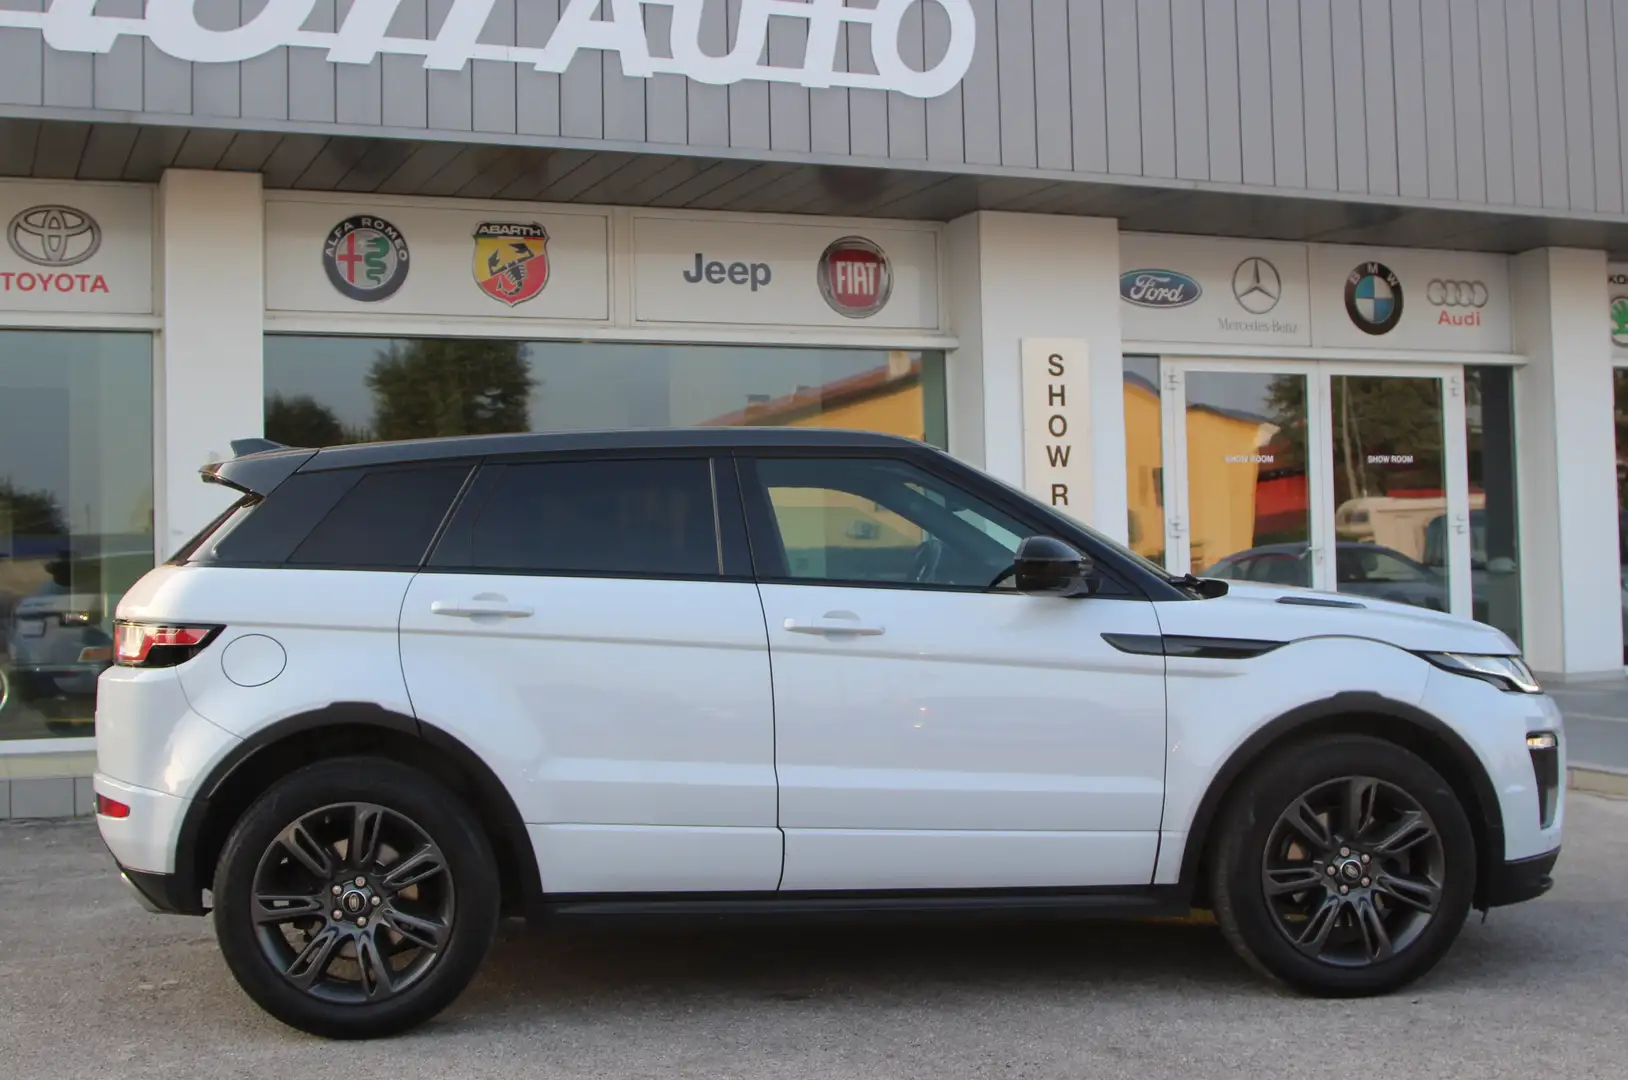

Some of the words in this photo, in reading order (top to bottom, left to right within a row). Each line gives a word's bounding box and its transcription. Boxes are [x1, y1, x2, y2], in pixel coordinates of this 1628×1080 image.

[325, 221, 354, 257] ALFA
[361, 217, 408, 262] ROMEO
[478, 225, 541, 236] ABARTH
[0, 272, 110, 293] TOYOTA
[682, 252, 772, 292] Jeep
[835, 260, 877, 296] FIAT
[1350, 263, 1399, 286] BMW
[1129, 274, 1185, 302] Ford
[1217, 317, 1298, 334] Mercedes-Benz
[1437, 310, 1481, 326] Audi
[1046, 353, 1072, 468] SHOW
[1225, 455, 1248, 463] SHOW
[1250, 455, 1274, 463] ROOM
[1367, 455, 1390, 463] SHOW
[1391, 455, 1414, 464] ROOM
